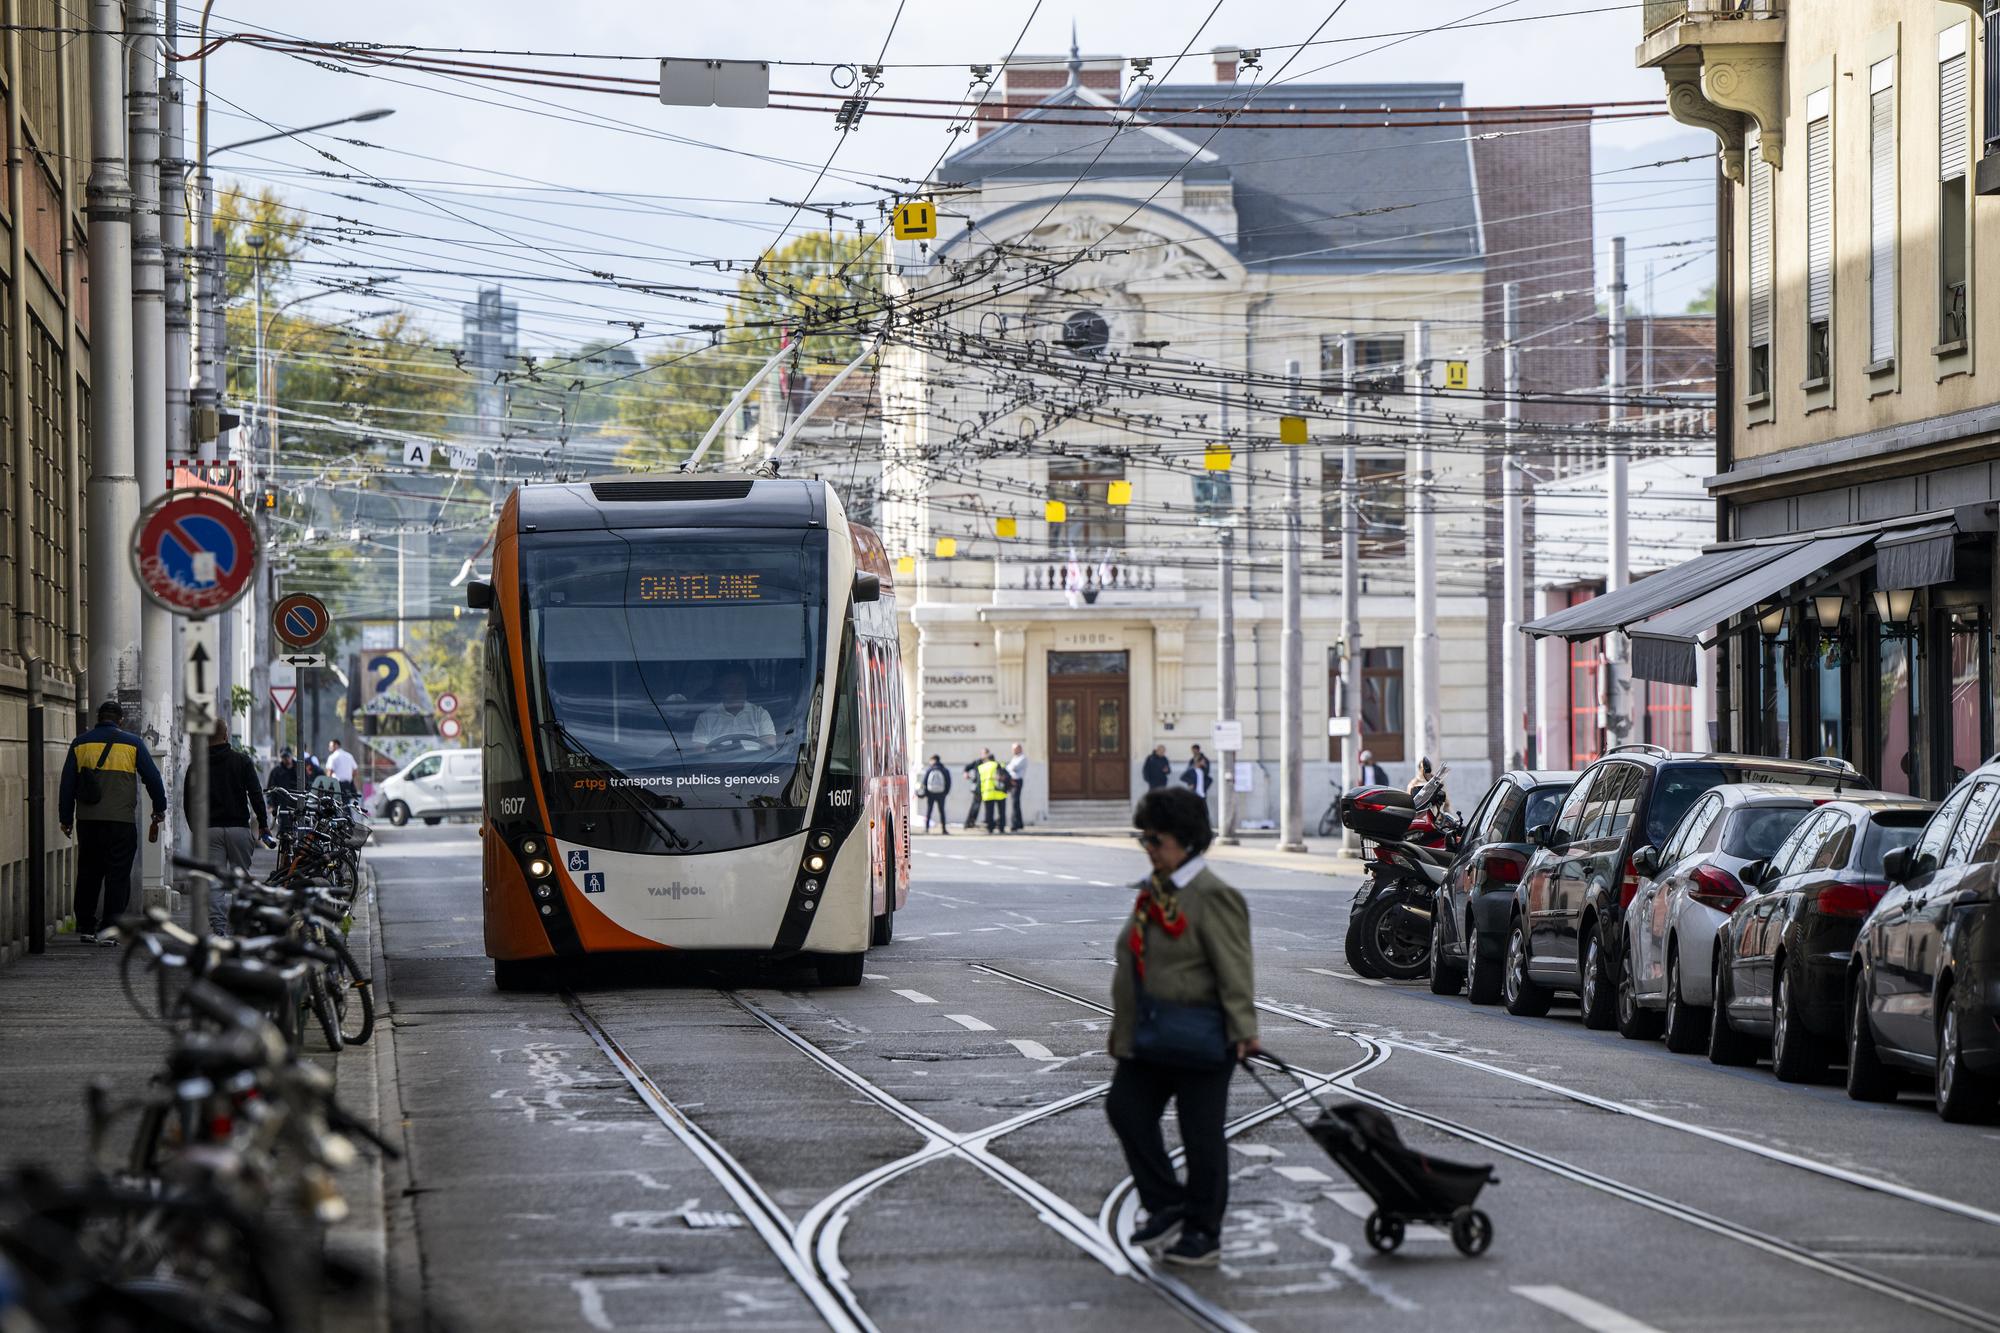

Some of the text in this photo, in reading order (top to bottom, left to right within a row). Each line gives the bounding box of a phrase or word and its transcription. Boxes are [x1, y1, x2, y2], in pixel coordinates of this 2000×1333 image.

[410, 446, 424, 462] A
[640, 575, 761, 600] CHATELAINE
[924, 675, 994, 685] TRANSPORTS
[923, 699, 968, 709] PUBLICS
[925, 724, 976, 733] GENEVOIS
[609, 776, 673, 789] transports
[676, 774, 721, 788] publics
[724, 774, 780, 788] genevois
[827, 789, 852, 807] 1607
[500, 797, 525, 815] 1607
